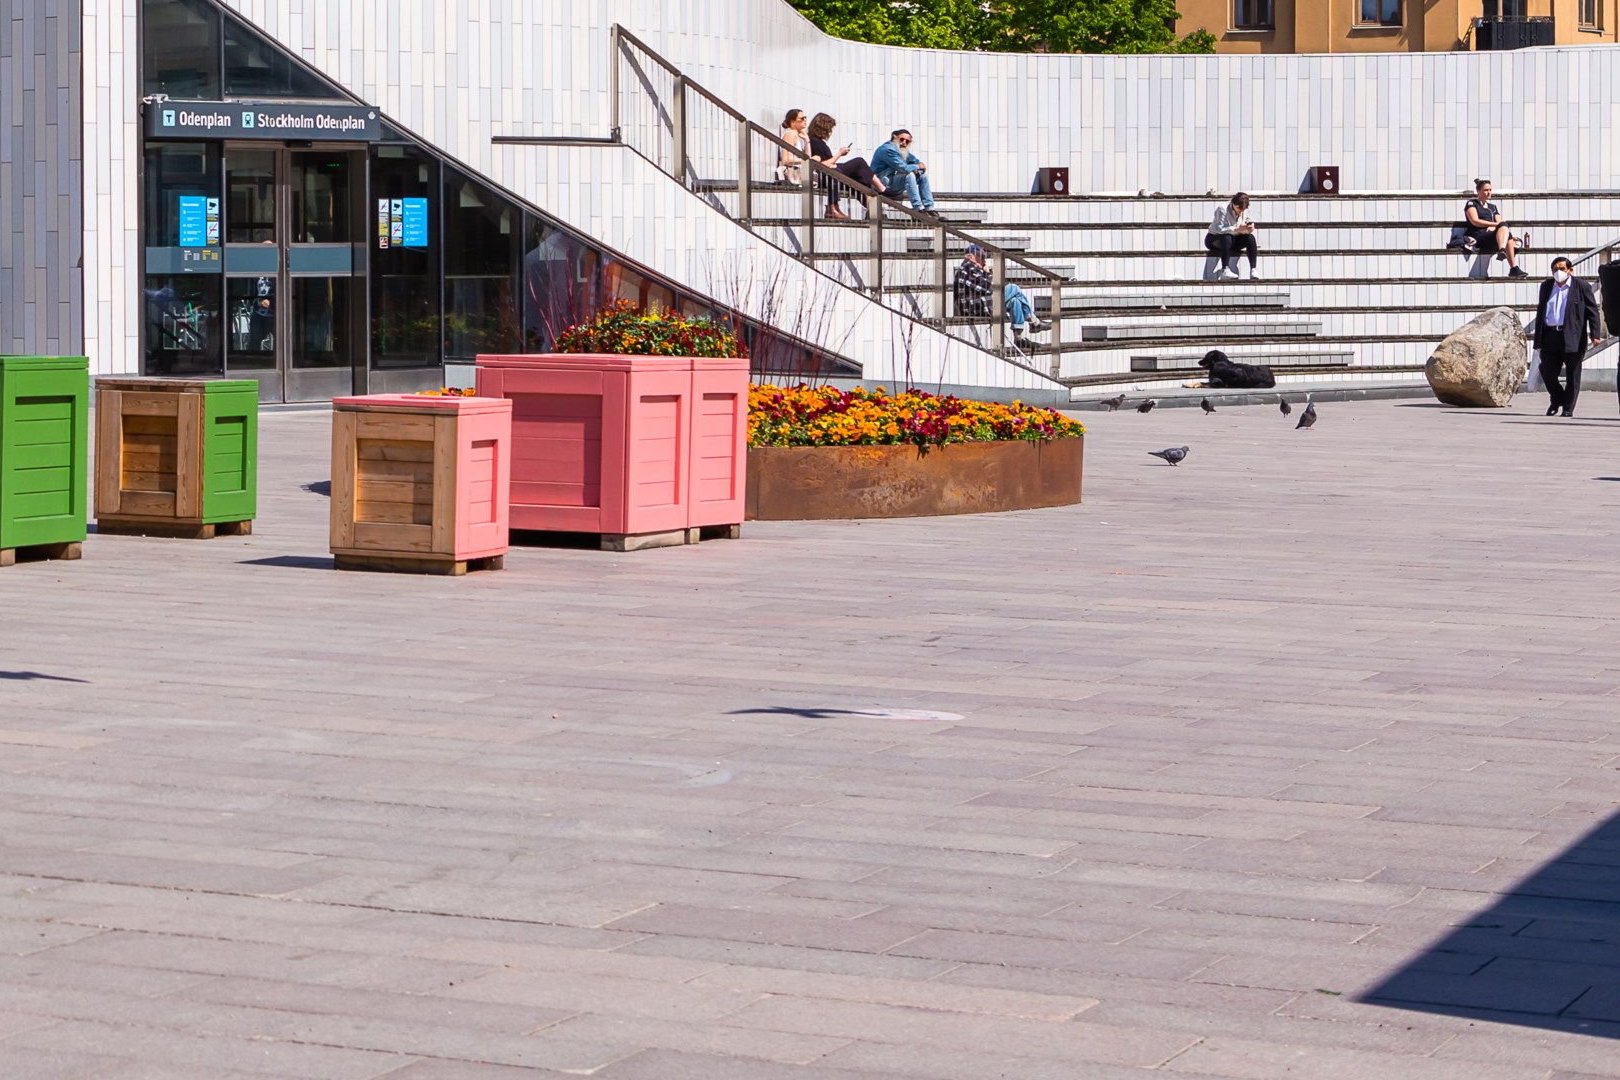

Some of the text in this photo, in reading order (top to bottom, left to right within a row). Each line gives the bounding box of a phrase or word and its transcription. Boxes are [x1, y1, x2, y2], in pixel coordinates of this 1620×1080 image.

[179, 111, 231, 130] Odenplan
[258, 113, 365, 132] Stockholm Odenplan
